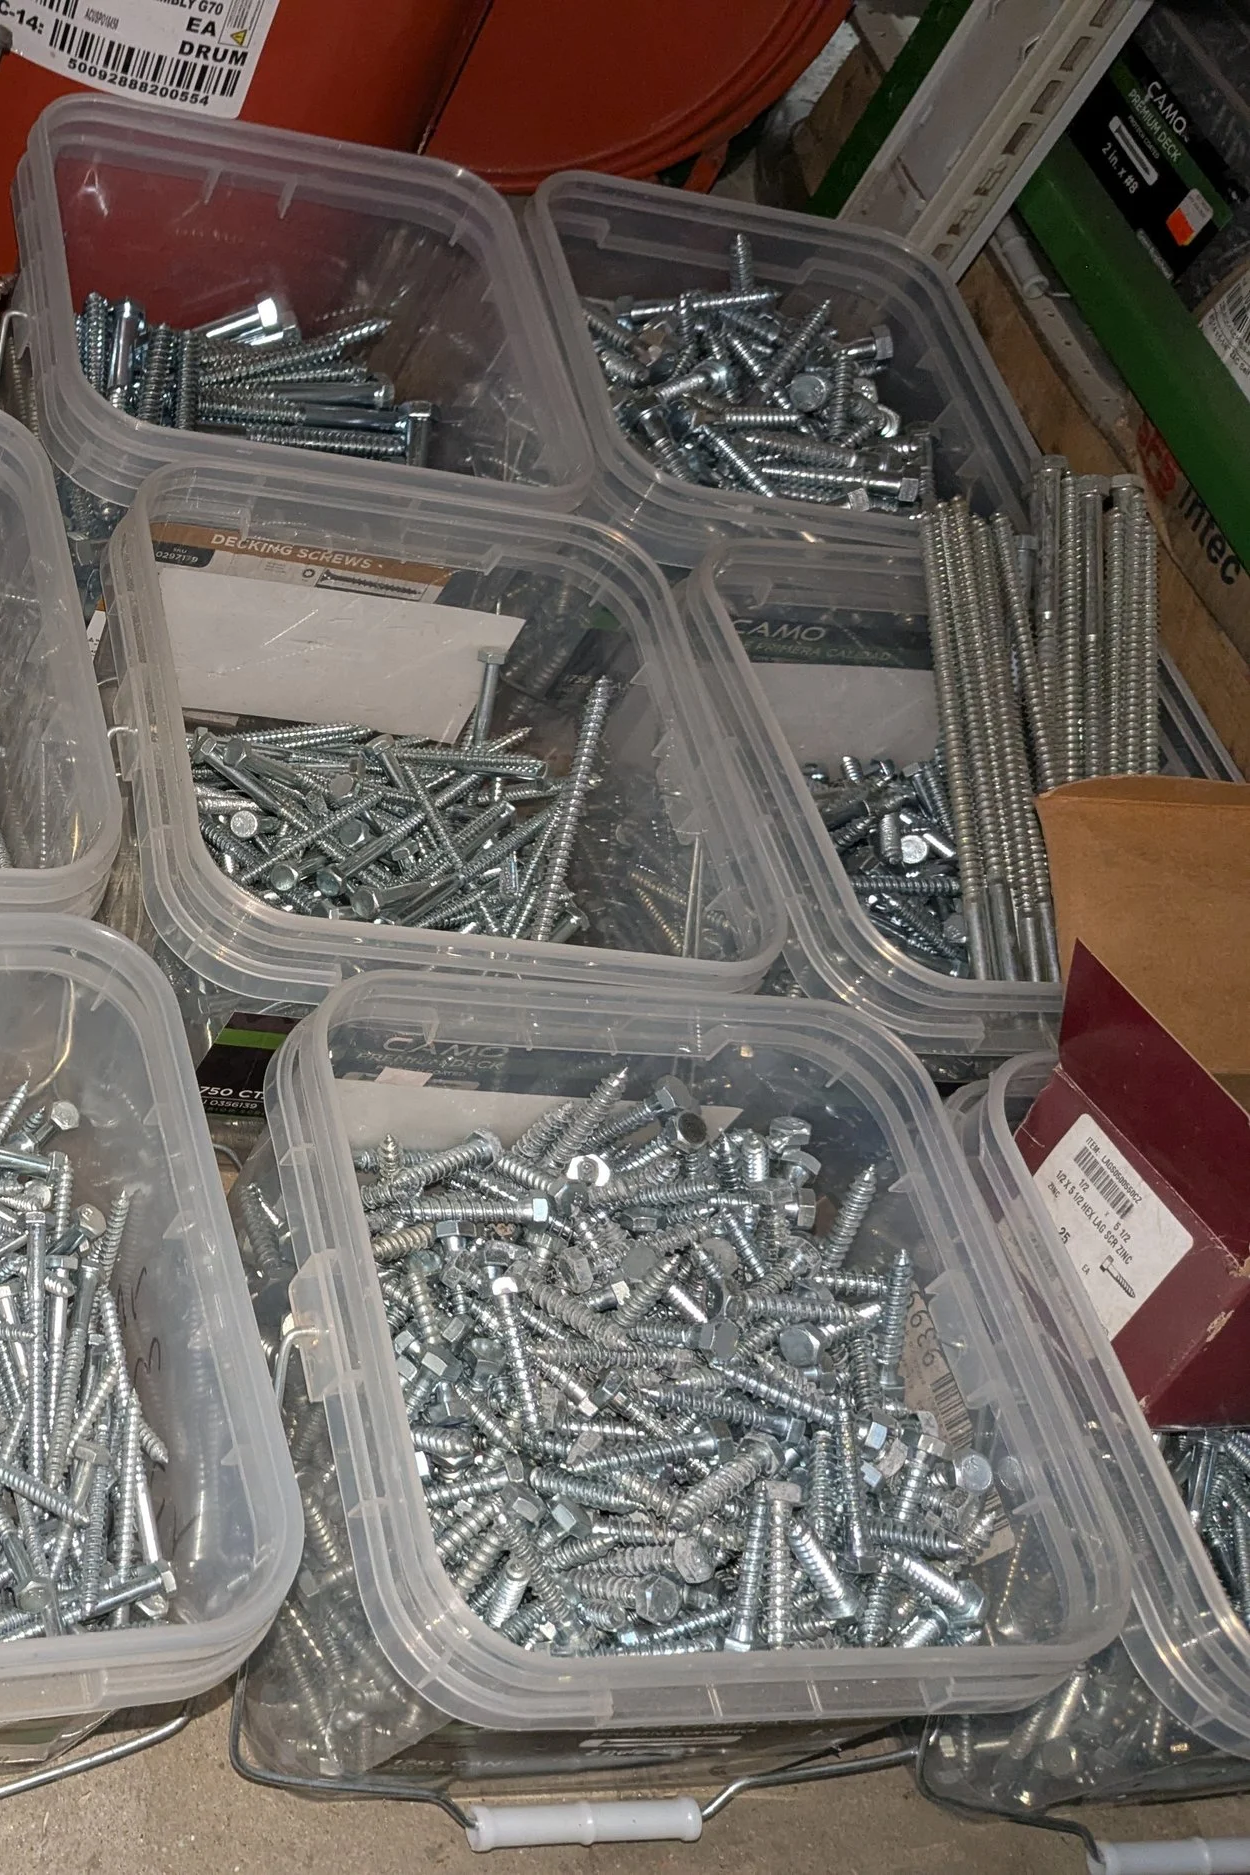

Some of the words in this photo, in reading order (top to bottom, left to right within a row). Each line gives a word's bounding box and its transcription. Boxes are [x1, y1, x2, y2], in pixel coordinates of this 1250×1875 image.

[198, 0, 225, 16] G70
[186, 16, 217, 37] EA
[178, 40, 249, 67] DRUM
[67, 58, 210, 107] 50092888200554
[1146, 81, 1188, 135] CAMO
[1128, 88, 1162, 135] PREMIUM
[1157, 131, 1182, 163] DECK
[1101, 142, 1112, 153] 2
[1123, 174, 1139, 195] #8
[211, 533, 293, 556] DECKING
[297, 547, 372, 569] SCREWS
[732, 619, 826, 642] CAMO
[383, 1037, 509, 1057] CAMO
[356, 1052, 446, 1070] PREMIUM
[451, 1057, 505, 1071] DECK
[210, 1100, 258, 1109] 0356139
[1086, 1136, 1101, 1156] ITEM:
[1056, 1169, 1067, 1183] 1/2
[1073, 1192, 1085, 1209] 1/2
[1081, 1202, 1095, 1221] HEX
[1092, 1216, 1106, 1235] LAG
[1103, 1230, 1118, 1250] SCR
[1116, 1243, 1133, 1265] ZINC
[1078, 1178, 1090, 1193] 1/2
[1119, 1228, 1132, 1244] 1/2
[1058, 1226, 1071, 1244] 25
[1081, 1263, 1091, 1276] EA
